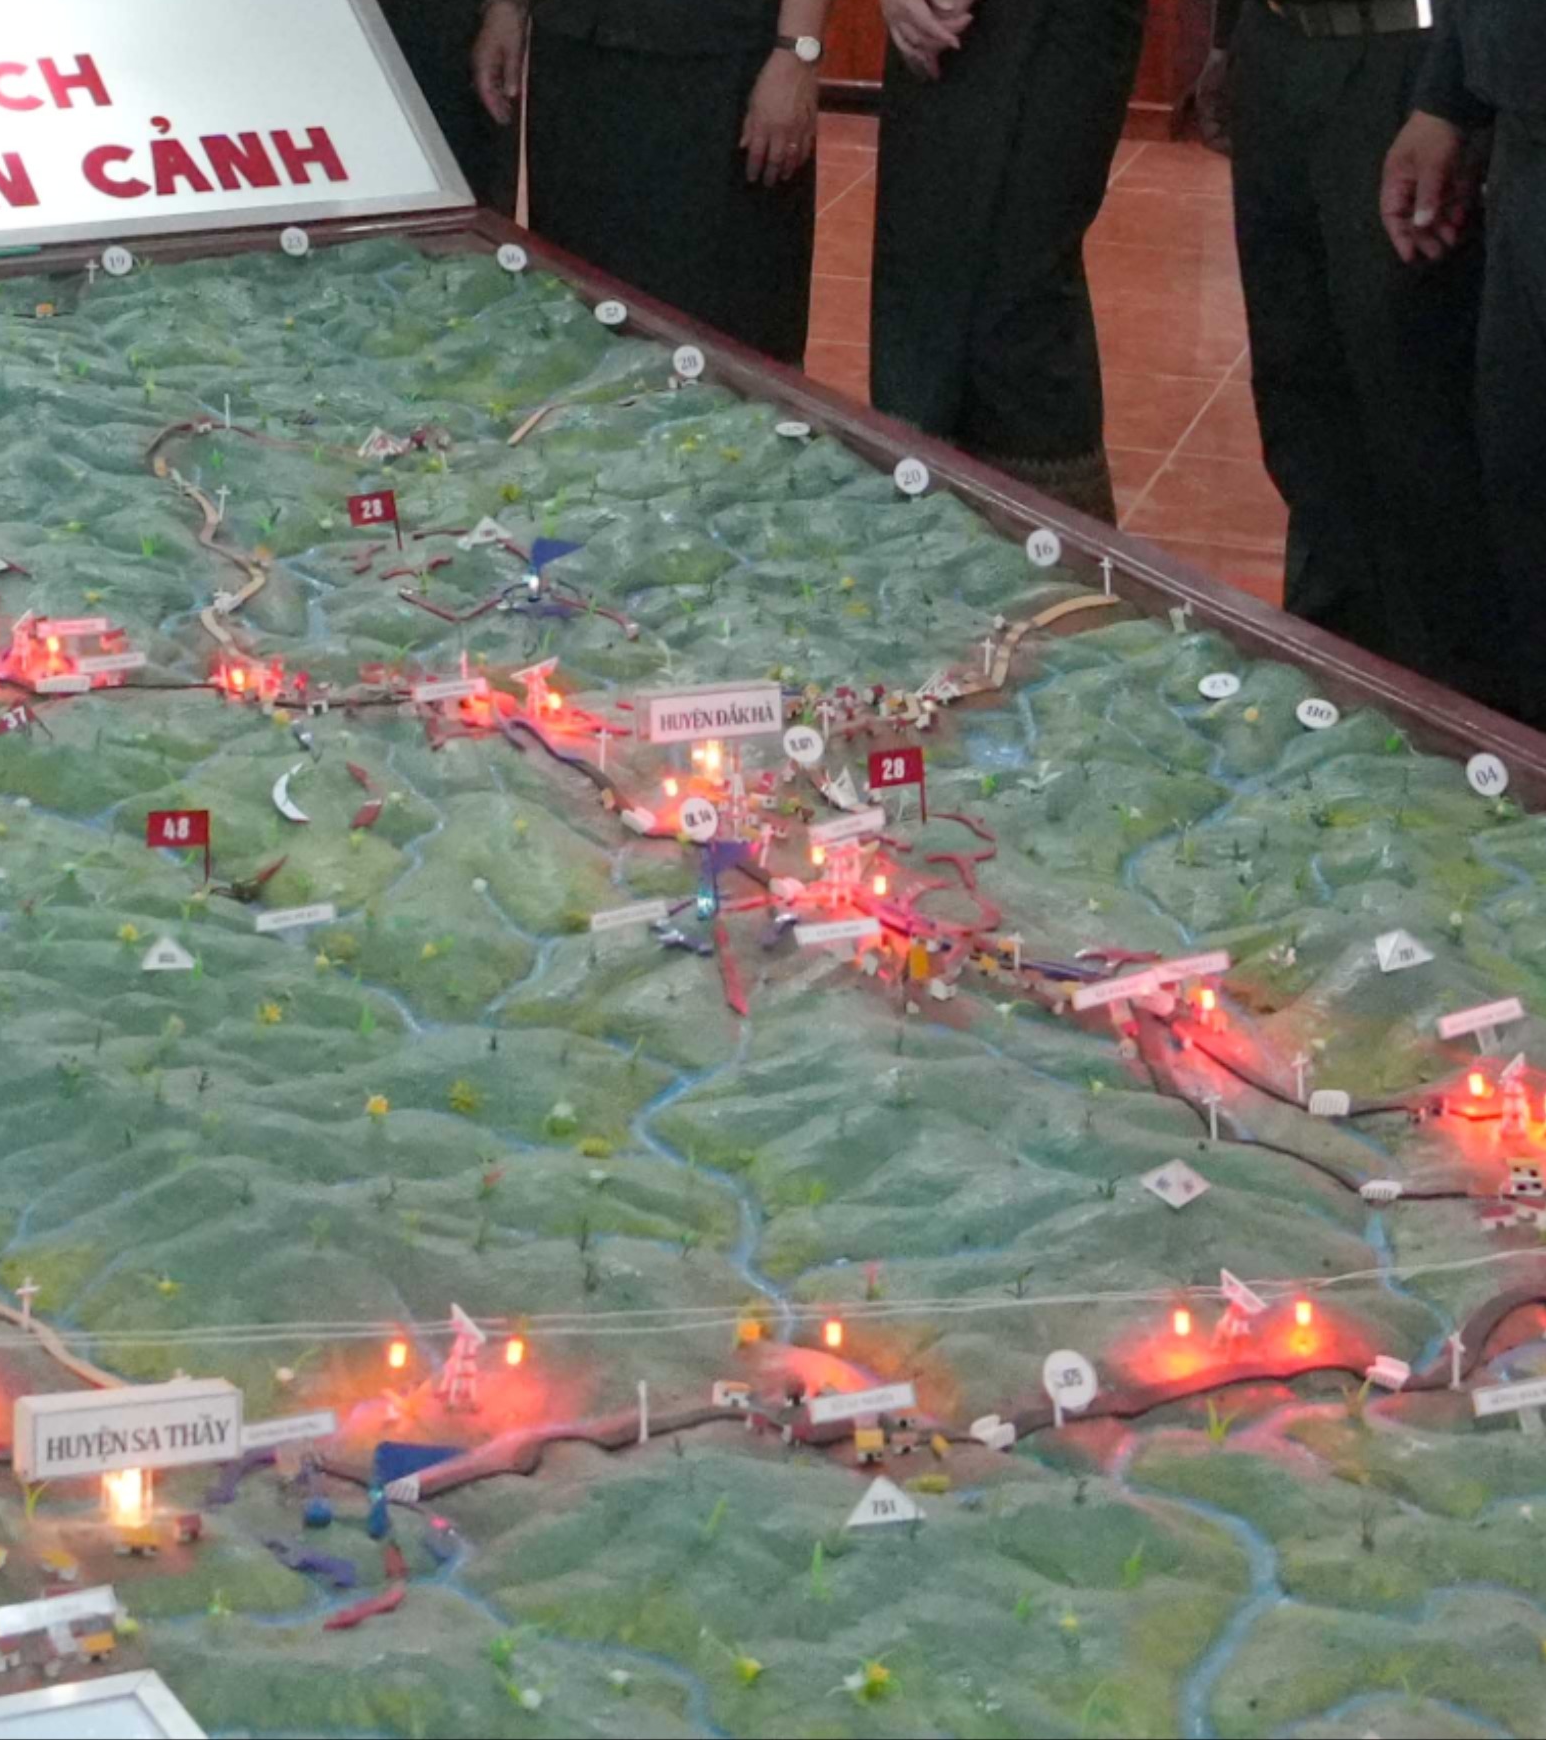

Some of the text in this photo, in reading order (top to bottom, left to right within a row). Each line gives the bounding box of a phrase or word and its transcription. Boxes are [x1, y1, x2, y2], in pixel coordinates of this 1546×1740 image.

[80, 114, 350, 202] CẢNH
[361, 498, 383, 520] 28
[659, 706, 713, 734] HUYỆN
[880, 756, 905, 781] 28
[1474, 766, 1499, 787] 04
[162, 817, 190, 841] 48
[45, 1412, 231, 1466] HUYỆN SA THẦY
